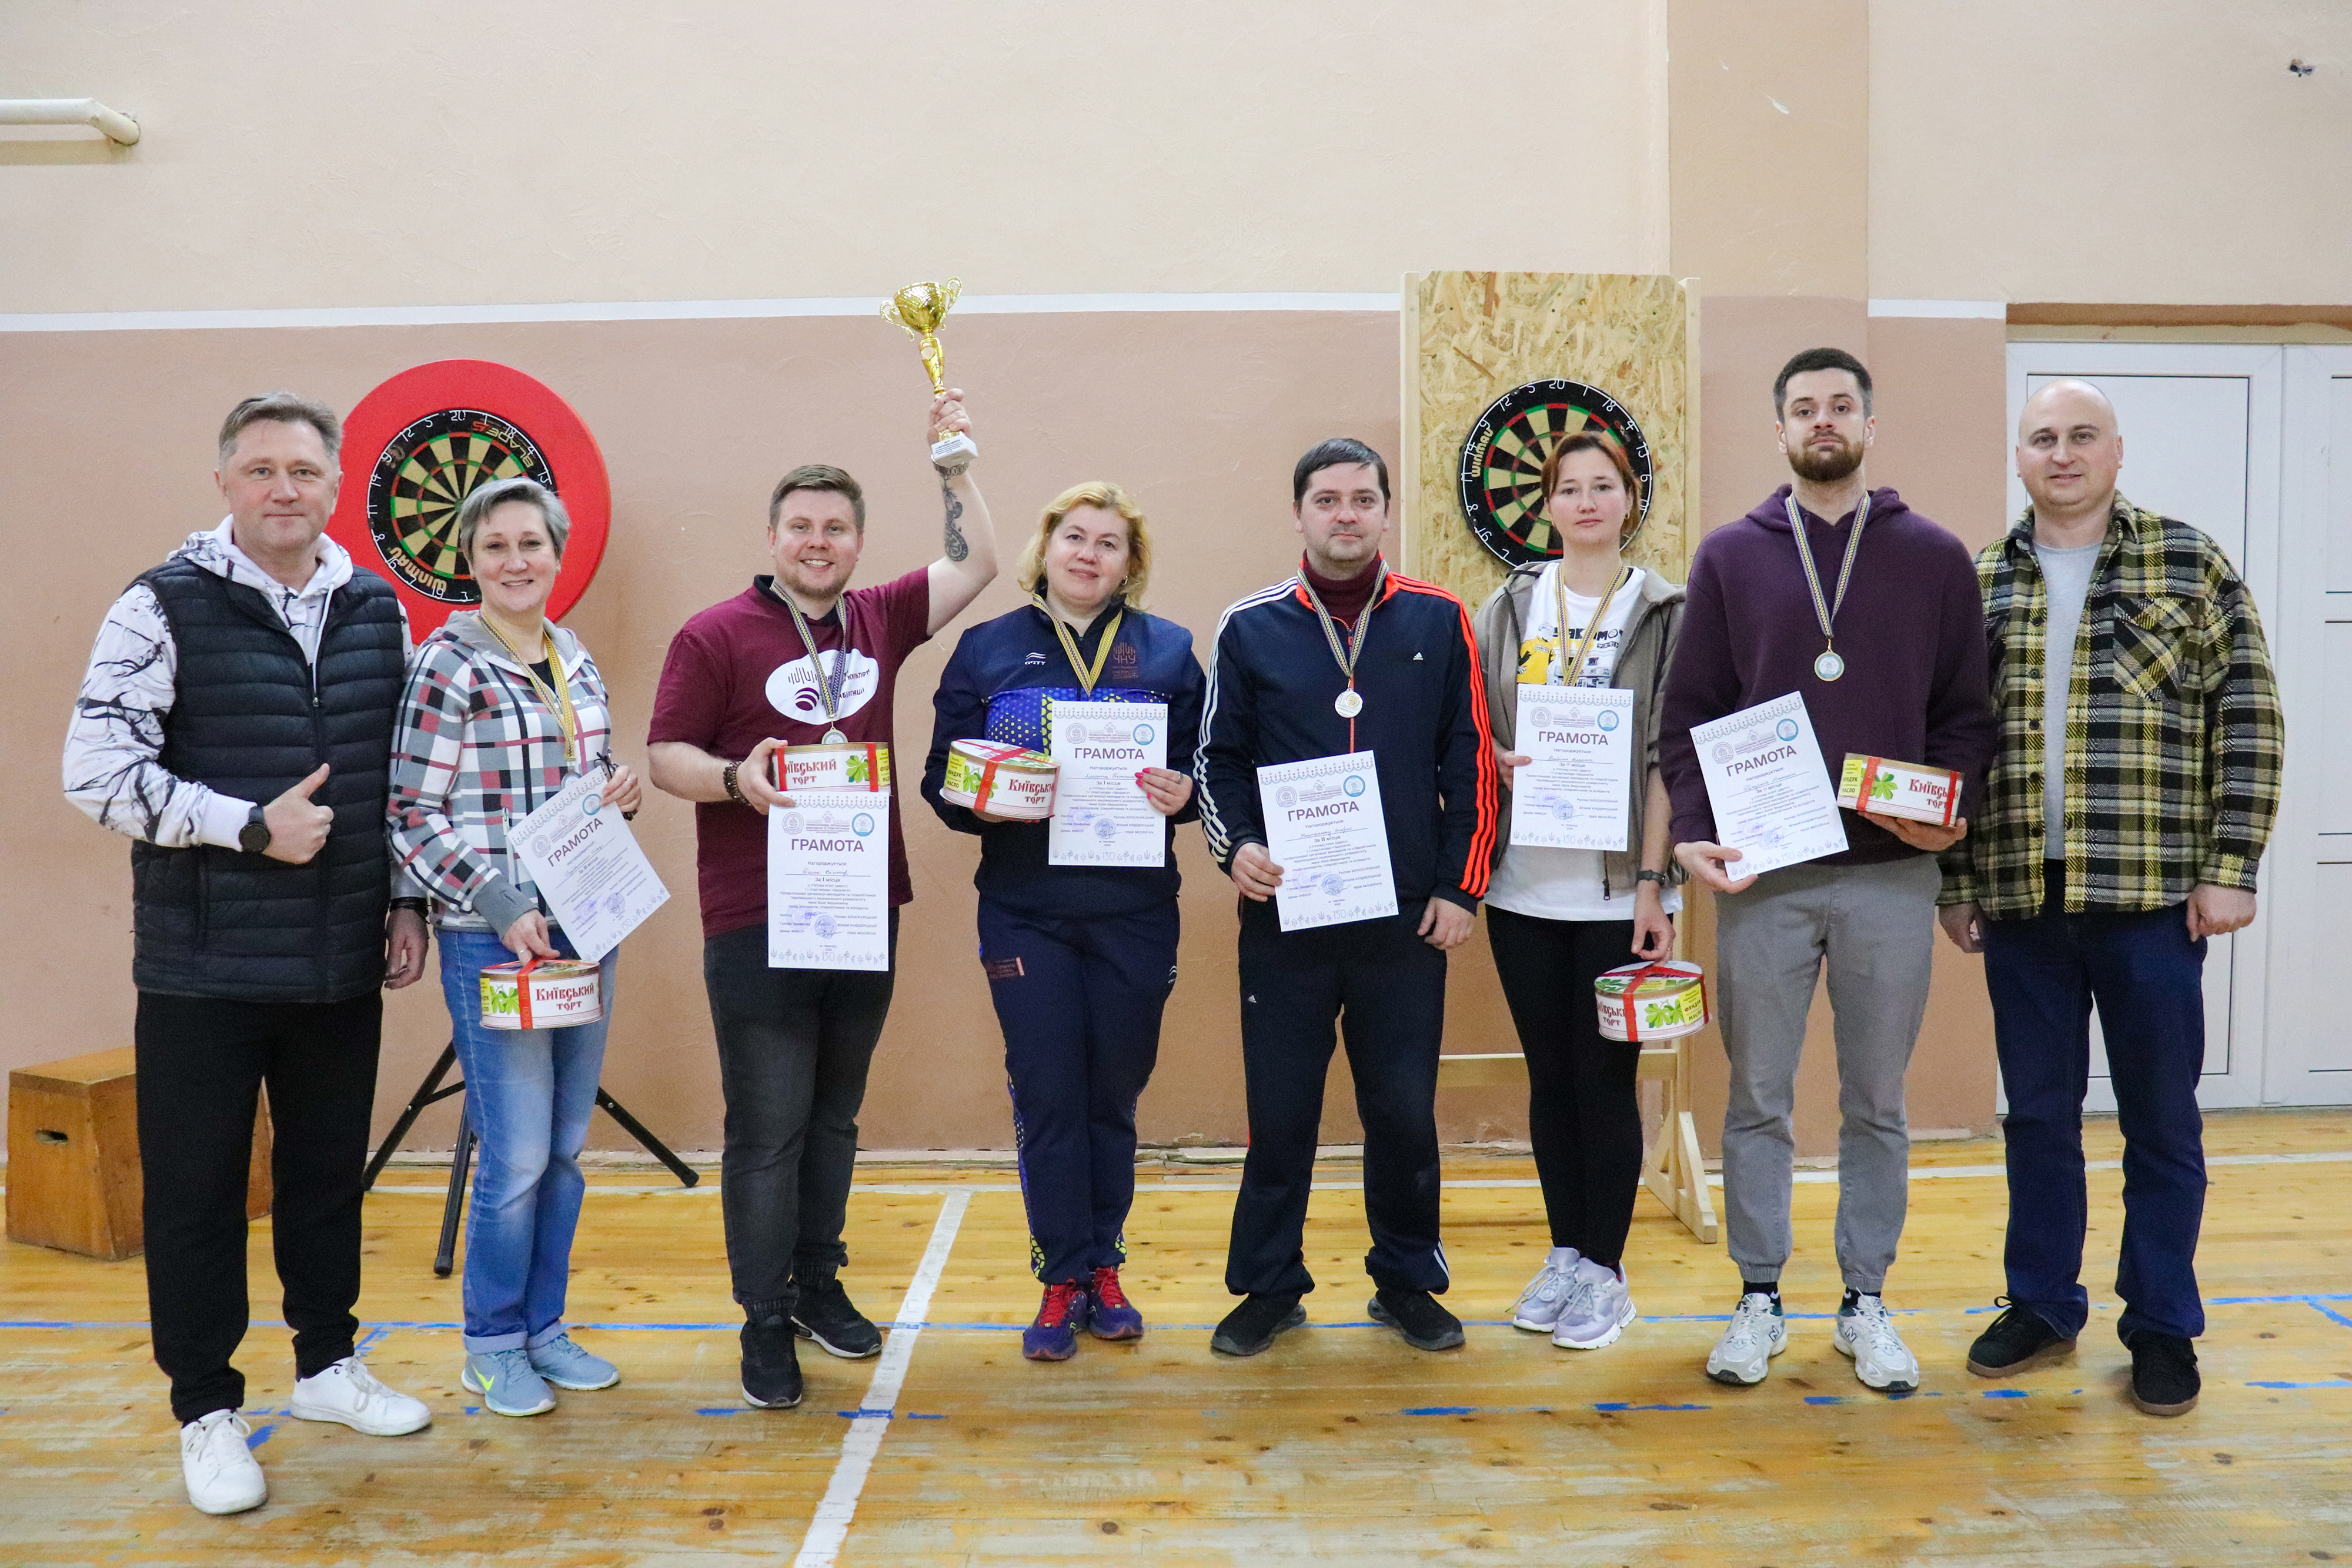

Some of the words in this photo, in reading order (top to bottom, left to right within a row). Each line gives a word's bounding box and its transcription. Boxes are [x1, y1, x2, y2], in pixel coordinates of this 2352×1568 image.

[1526, 384, 1535, 393] 5
[1549, 379, 1565, 389] 20
[1499, 396, 1512, 412] 12
[1602, 397, 1616, 412] 18
[449, 410, 466, 421] 20
[424, 419, 433, 428] 5
[1479, 419, 1491, 430] 9
[1626, 420, 1636, 430] 4
[400, 427, 415, 442] 12
[505, 424, 518, 439] 18
[382, 452, 393, 463] 9
[527, 446, 536, 456] 4
[1471, 429, 1494, 477] WINMAU
[369, 473, 382, 487] 14
[1466, 504, 1479, 512] 8
[373, 533, 386, 542] 8
[1475, 527, 1492, 541] 16
[389, 547, 447, 593] WINMAU
[1539, 731, 1608, 745] ГРАМОТА
[1075, 748, 1144, 760] ГРАМОТА
[1726, 745, 1797, 777] ГРАМОТА
[1008, 778, 1055, 795] Київськи
[1288, 801, 1359, 822] ГРАМОТА
[547, 817, 603, 867] ГРАМОТА
[791, 839, 864, 852] ГРАМОТА
[1563, 835, 1575, 844] 150
[1102, 852, 1115, 861] 150
[1782, 851, 1795, 862] 150
[1333, 910, 1346, 920] 150
[822, 952, 835, 961] 150
[536, 982, 594, 1002] Київський
[1769, 1326, 1779, 1342] N
[1845, 1327, 1857, 1342] N
